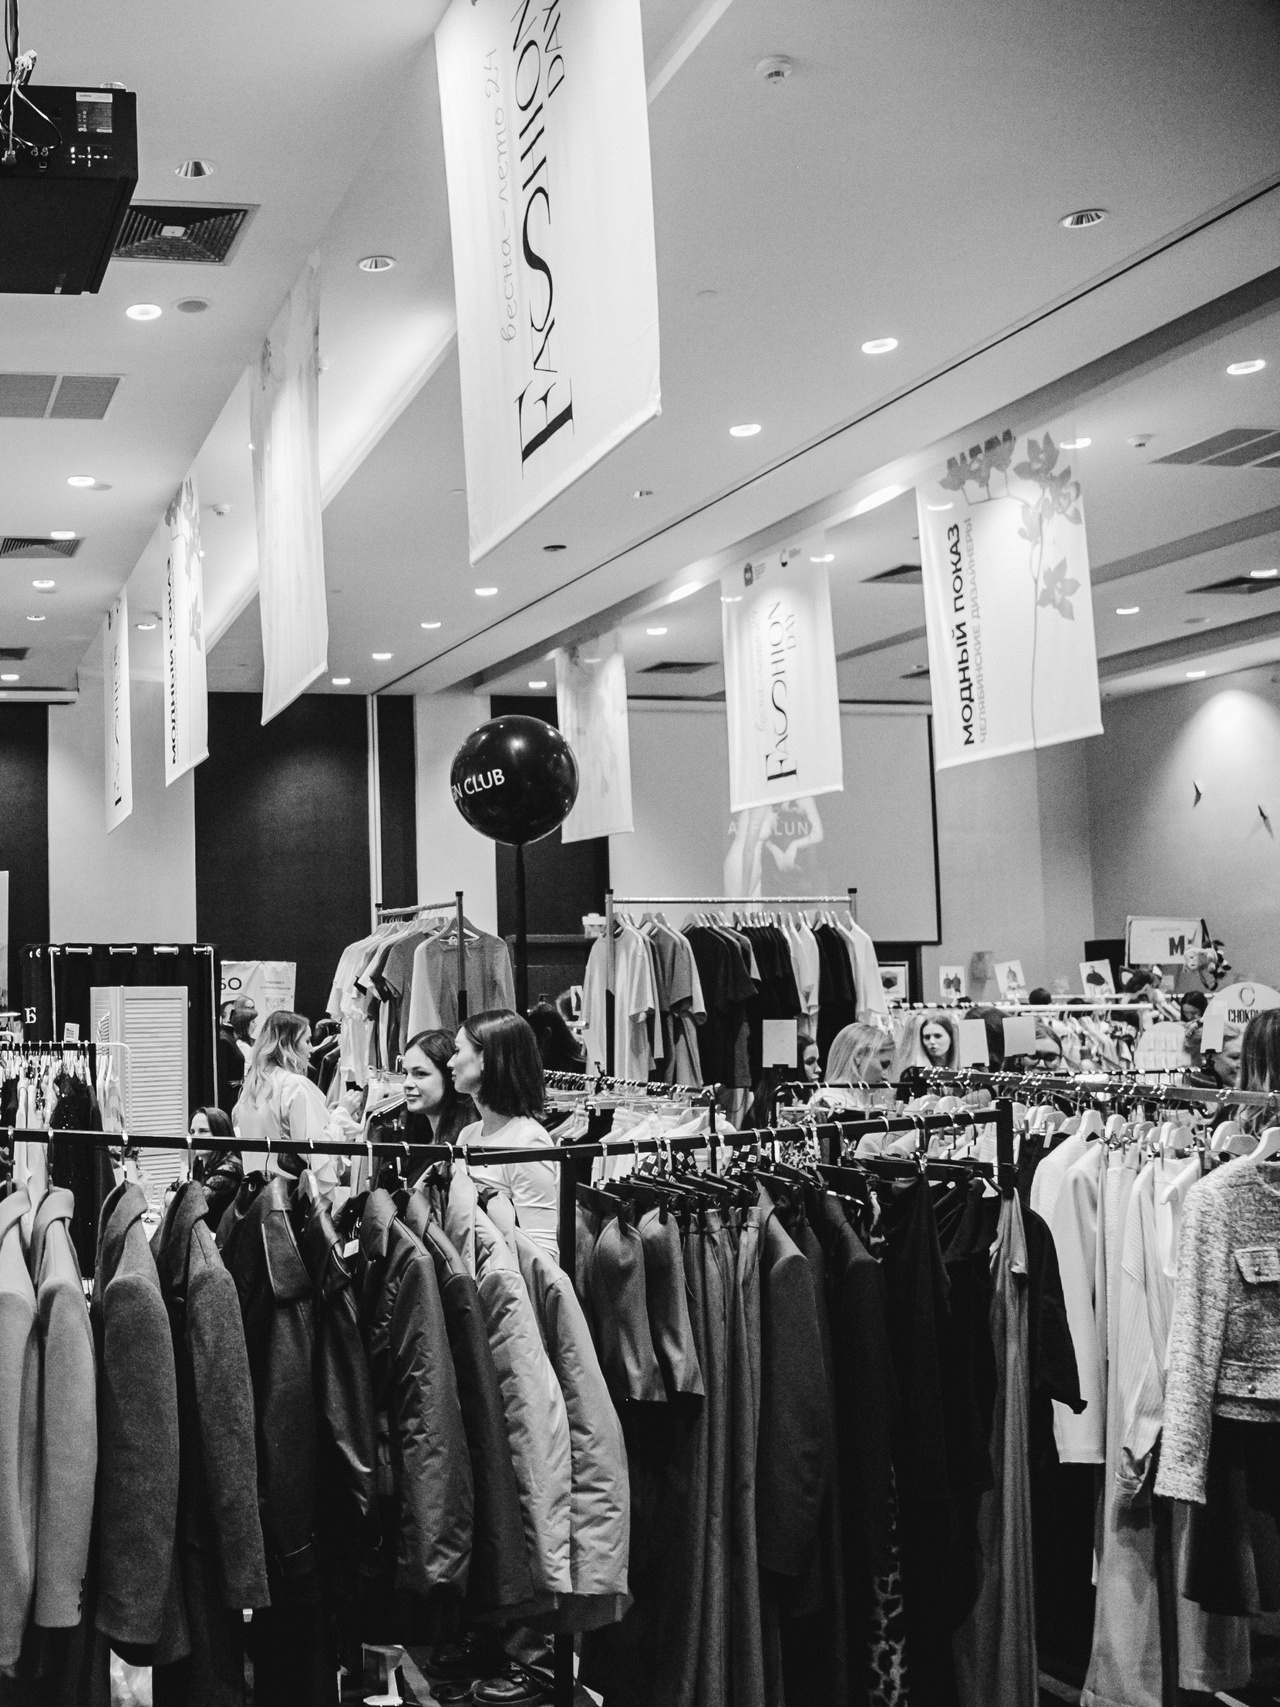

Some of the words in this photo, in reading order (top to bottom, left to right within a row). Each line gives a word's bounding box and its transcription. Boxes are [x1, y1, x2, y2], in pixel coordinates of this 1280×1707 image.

[483, 48, 500, 98] 24
[510, 0, 576, 479] FASHION
[947, 523, 965, 613] ПОКАЗ
[765, 601, 798, 785] FASHION
[951, 621, 975, 746] МОДНЫЙ
[464, 768, 505, 795] CLUB
